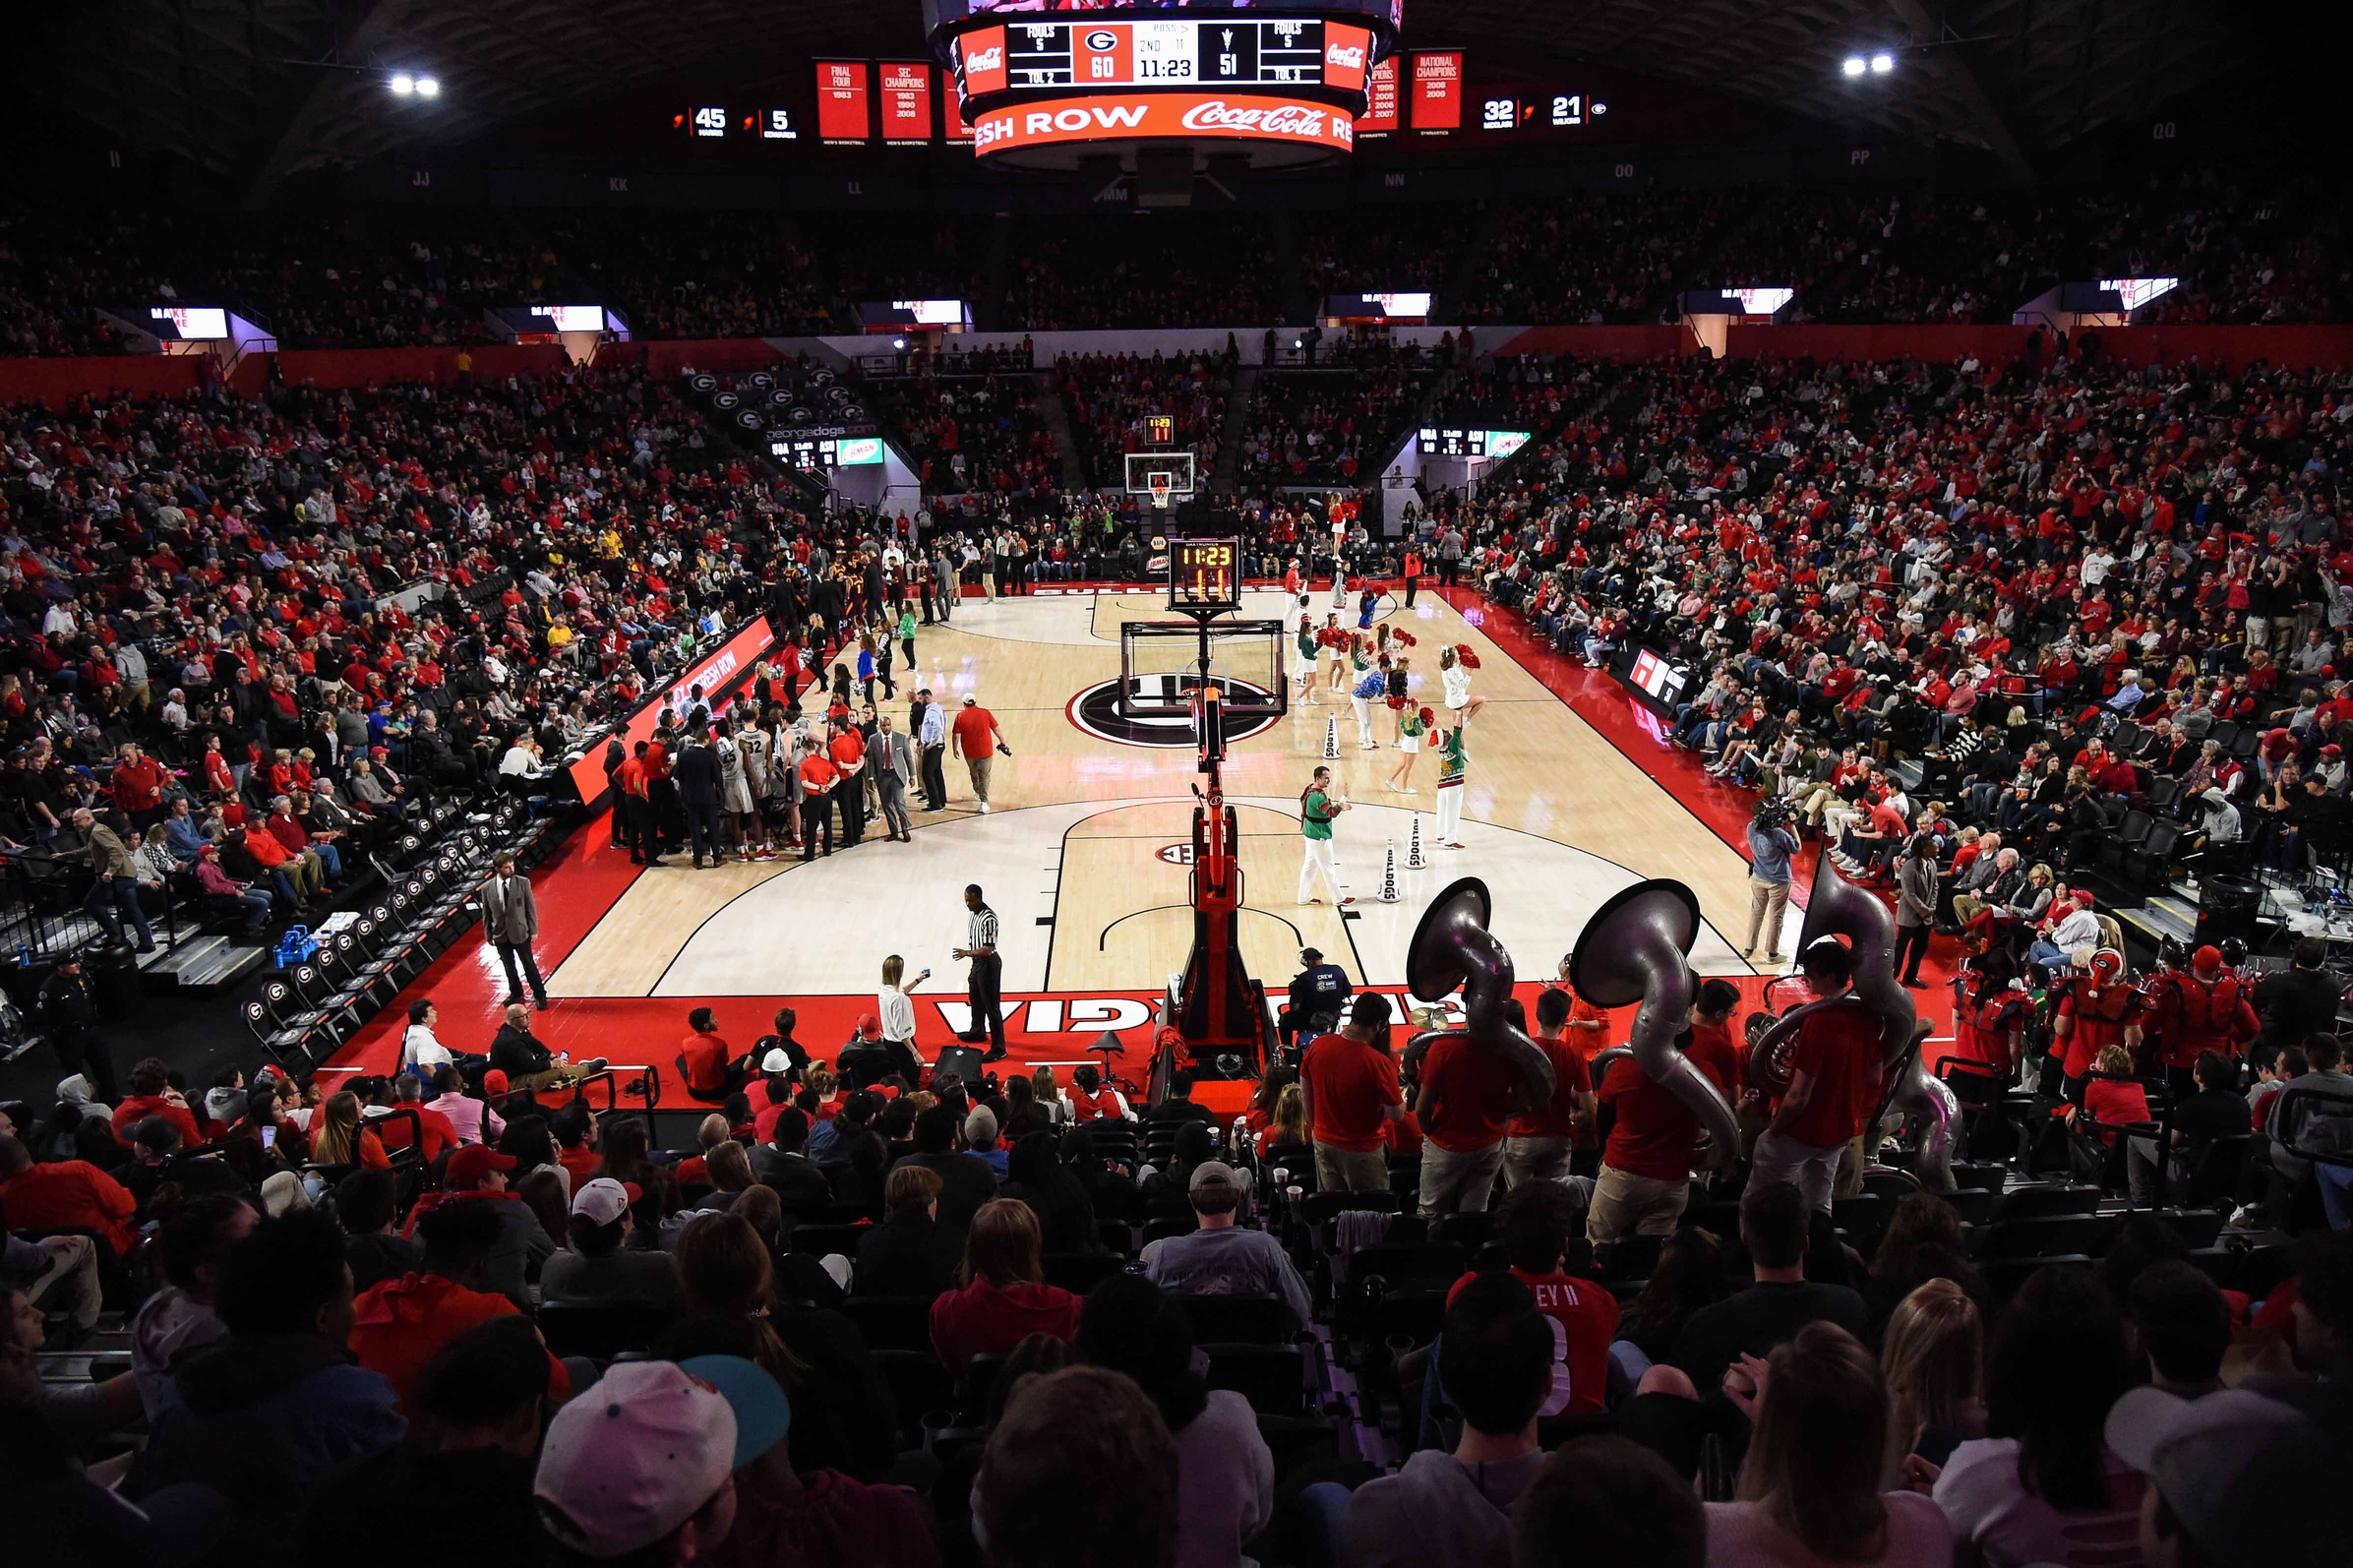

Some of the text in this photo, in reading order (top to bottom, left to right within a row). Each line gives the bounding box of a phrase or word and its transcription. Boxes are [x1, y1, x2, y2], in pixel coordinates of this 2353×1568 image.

[1027, 26, 1055, 37] FOULS
[1274, 23, 1302, 34] FOULS
[1036, 38, 1044, 51] 5
[1139, 39, 1162, 52] 2ND
[1284, 35, 1293, 48] 5
[1091, 56, 1115, 78] 60
[1220, 53, 1237, 76] 51
[1419, 56, 1454, 67] NATIONAL
[831, 66, 851, 77] FINAL
[898, 67, 911, 78] SEC
[1140, 59, 1192, 78] 11:23
[1417, 67, 1457, 78] CHAMPIONS
[833, 77, 851, 87] FOUR
[885, 78, 925, 89] CHAMPIONS
[1484, 100, 1514, 120] 32
[1552, 95, 1580, 116] 21
[695, 108, 726, 128] 45
[772, 110, 788, 130] 5
[1026, 105, 1149, 135] ROW
[1181, 101, 1328, 138] Coca-Cola
[2099, 279, 2136, 290] MAKE
[1361, 293, 1395, 302] MAKE
[1721, 289, 1755, 298] MAKE
[531, 306, 566, 316] MAKE
[892, 301, 926, 310] MAKE
[151, 308, 188, 319] MAKE
[1150, 418, 1171, 428] 11:23
[1155, 427, 1169, 441] 11
[1183, 548, 1231, 566] 11:23
[1197, 568, 1224, 598] 11
[1410, 818, 1420, 867] BULLDOGS
[1384, 849, 1396, 899] BULLDOGS
